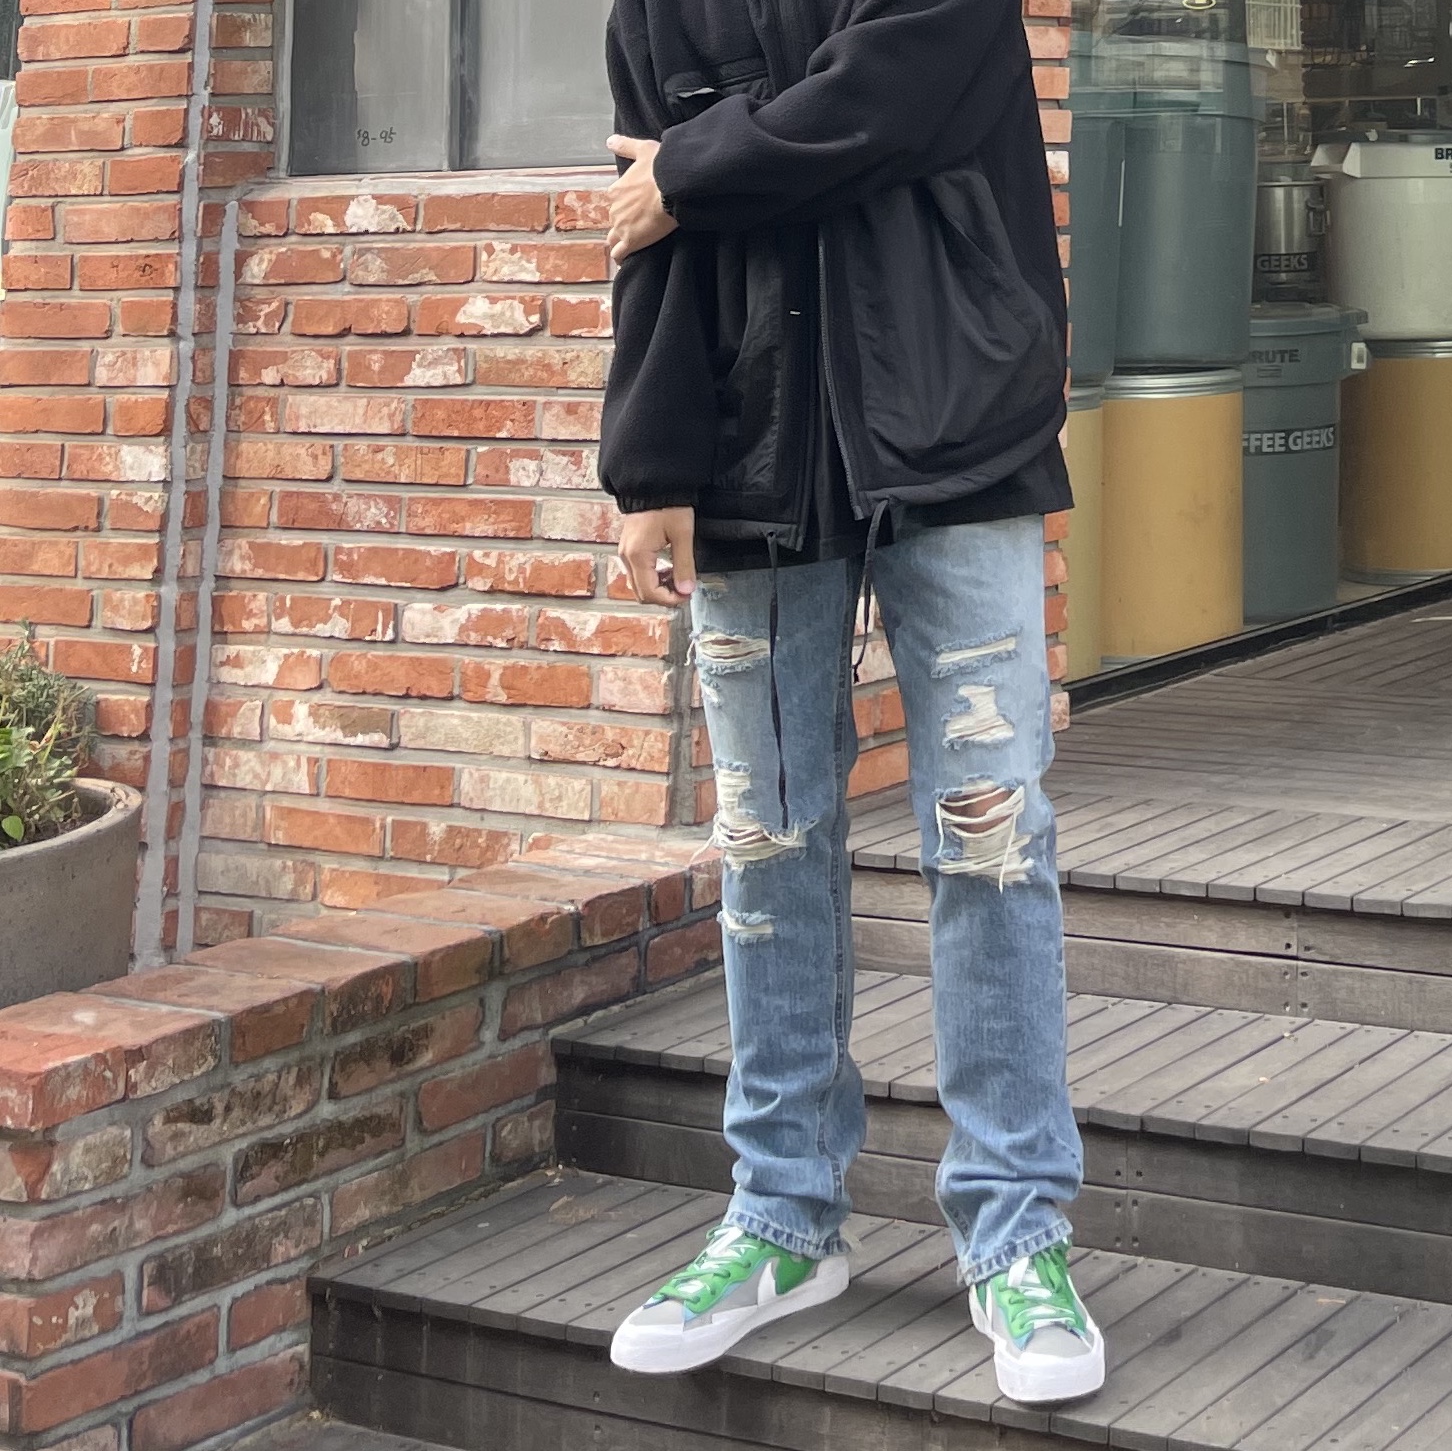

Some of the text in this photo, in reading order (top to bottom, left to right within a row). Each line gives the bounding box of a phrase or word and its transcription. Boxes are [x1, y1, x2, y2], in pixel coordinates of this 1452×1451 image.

[1257, 254, 1308, 271] GEEKS
[1249, 349, 1300, 364] RUTE
[1288, 427, 1334, 450] GEEKS
